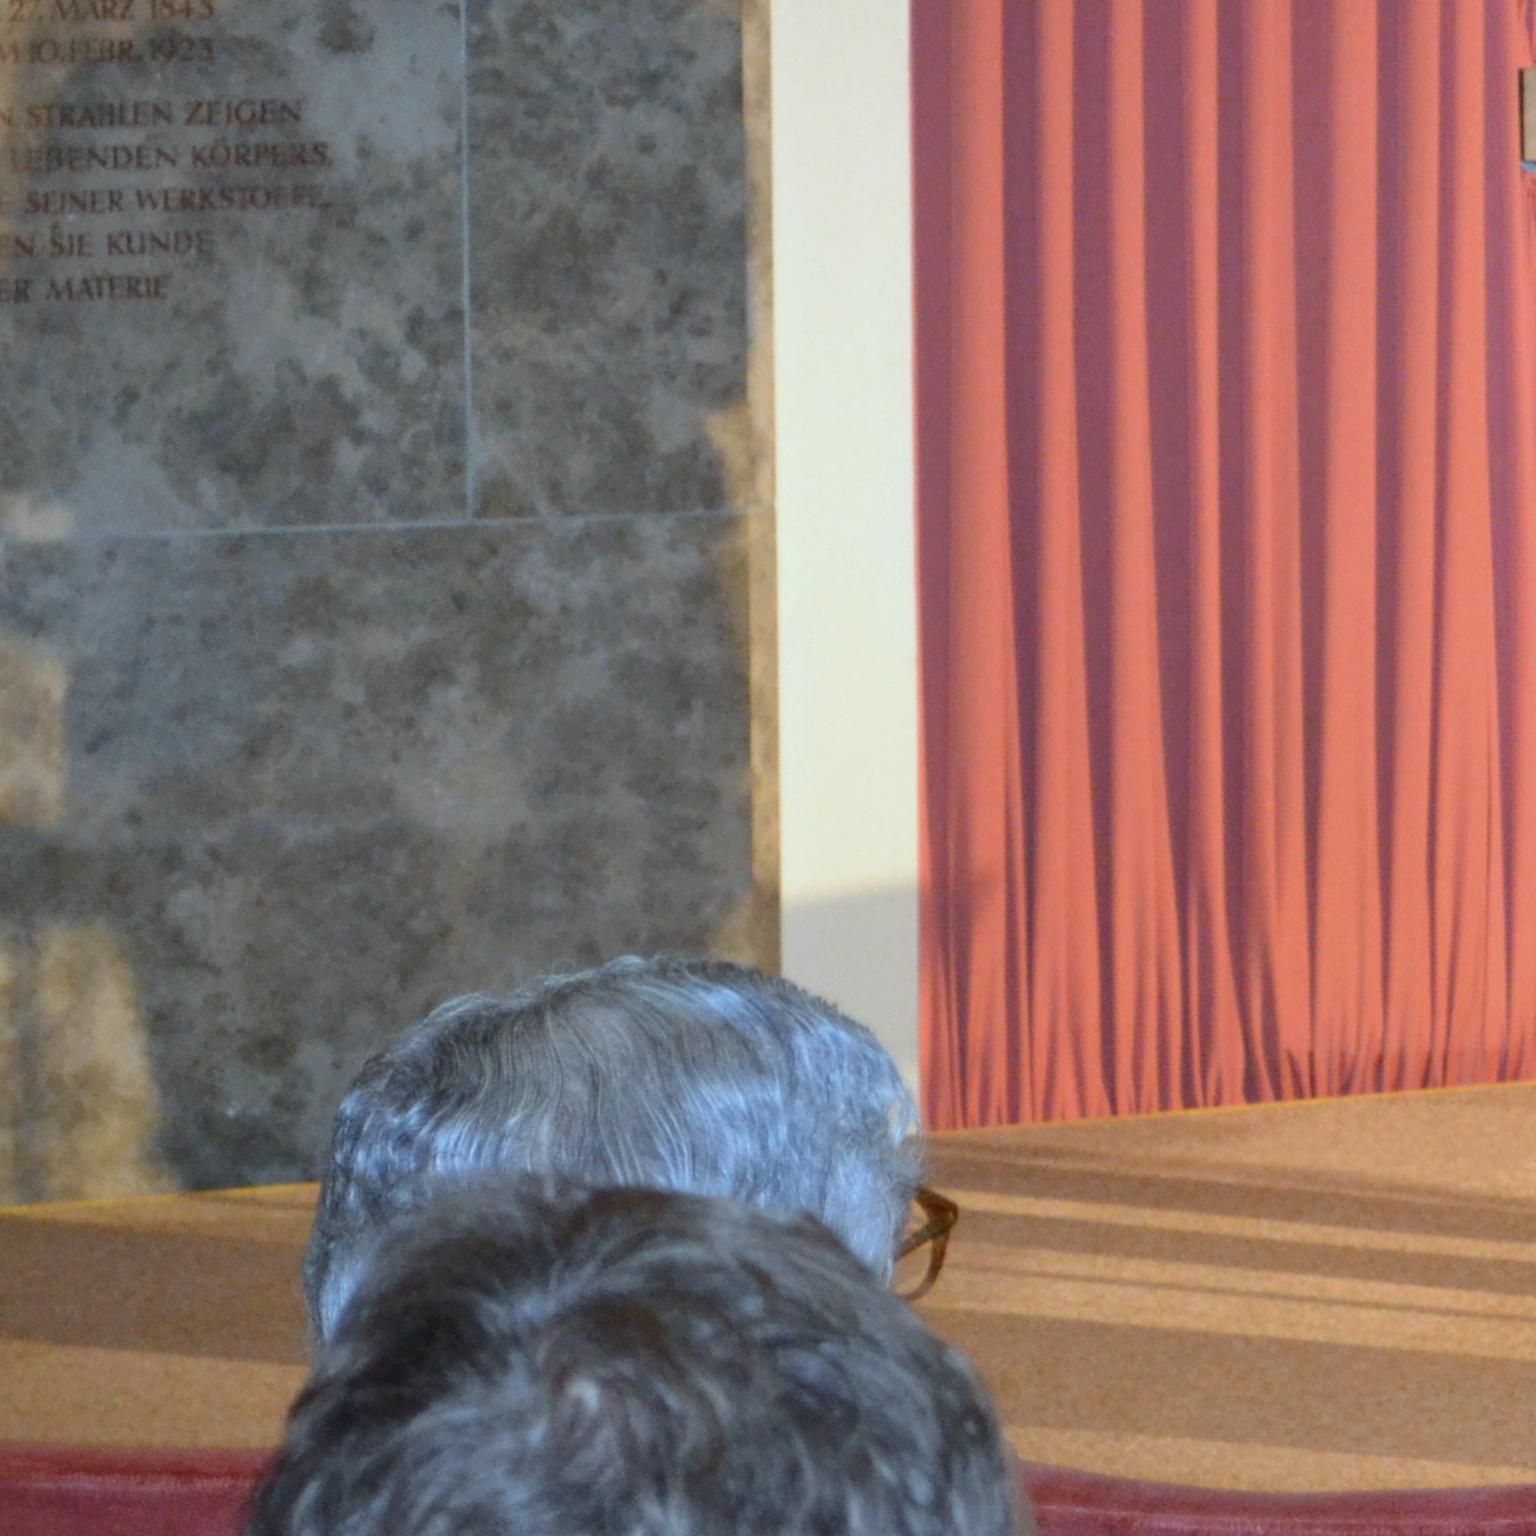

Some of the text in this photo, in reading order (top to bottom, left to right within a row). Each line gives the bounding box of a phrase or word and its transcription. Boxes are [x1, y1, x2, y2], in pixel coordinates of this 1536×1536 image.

[26, 100, 173, 128] STRAHLEN
[184, 97, 303, 127] ZEIGEN
[25, 188, 125, 215] SEINER
[49, 231, 94, 258] SIE
[106, 228, 215, 257] KUNDE
[47, 272, 171, 302] MATERIE
